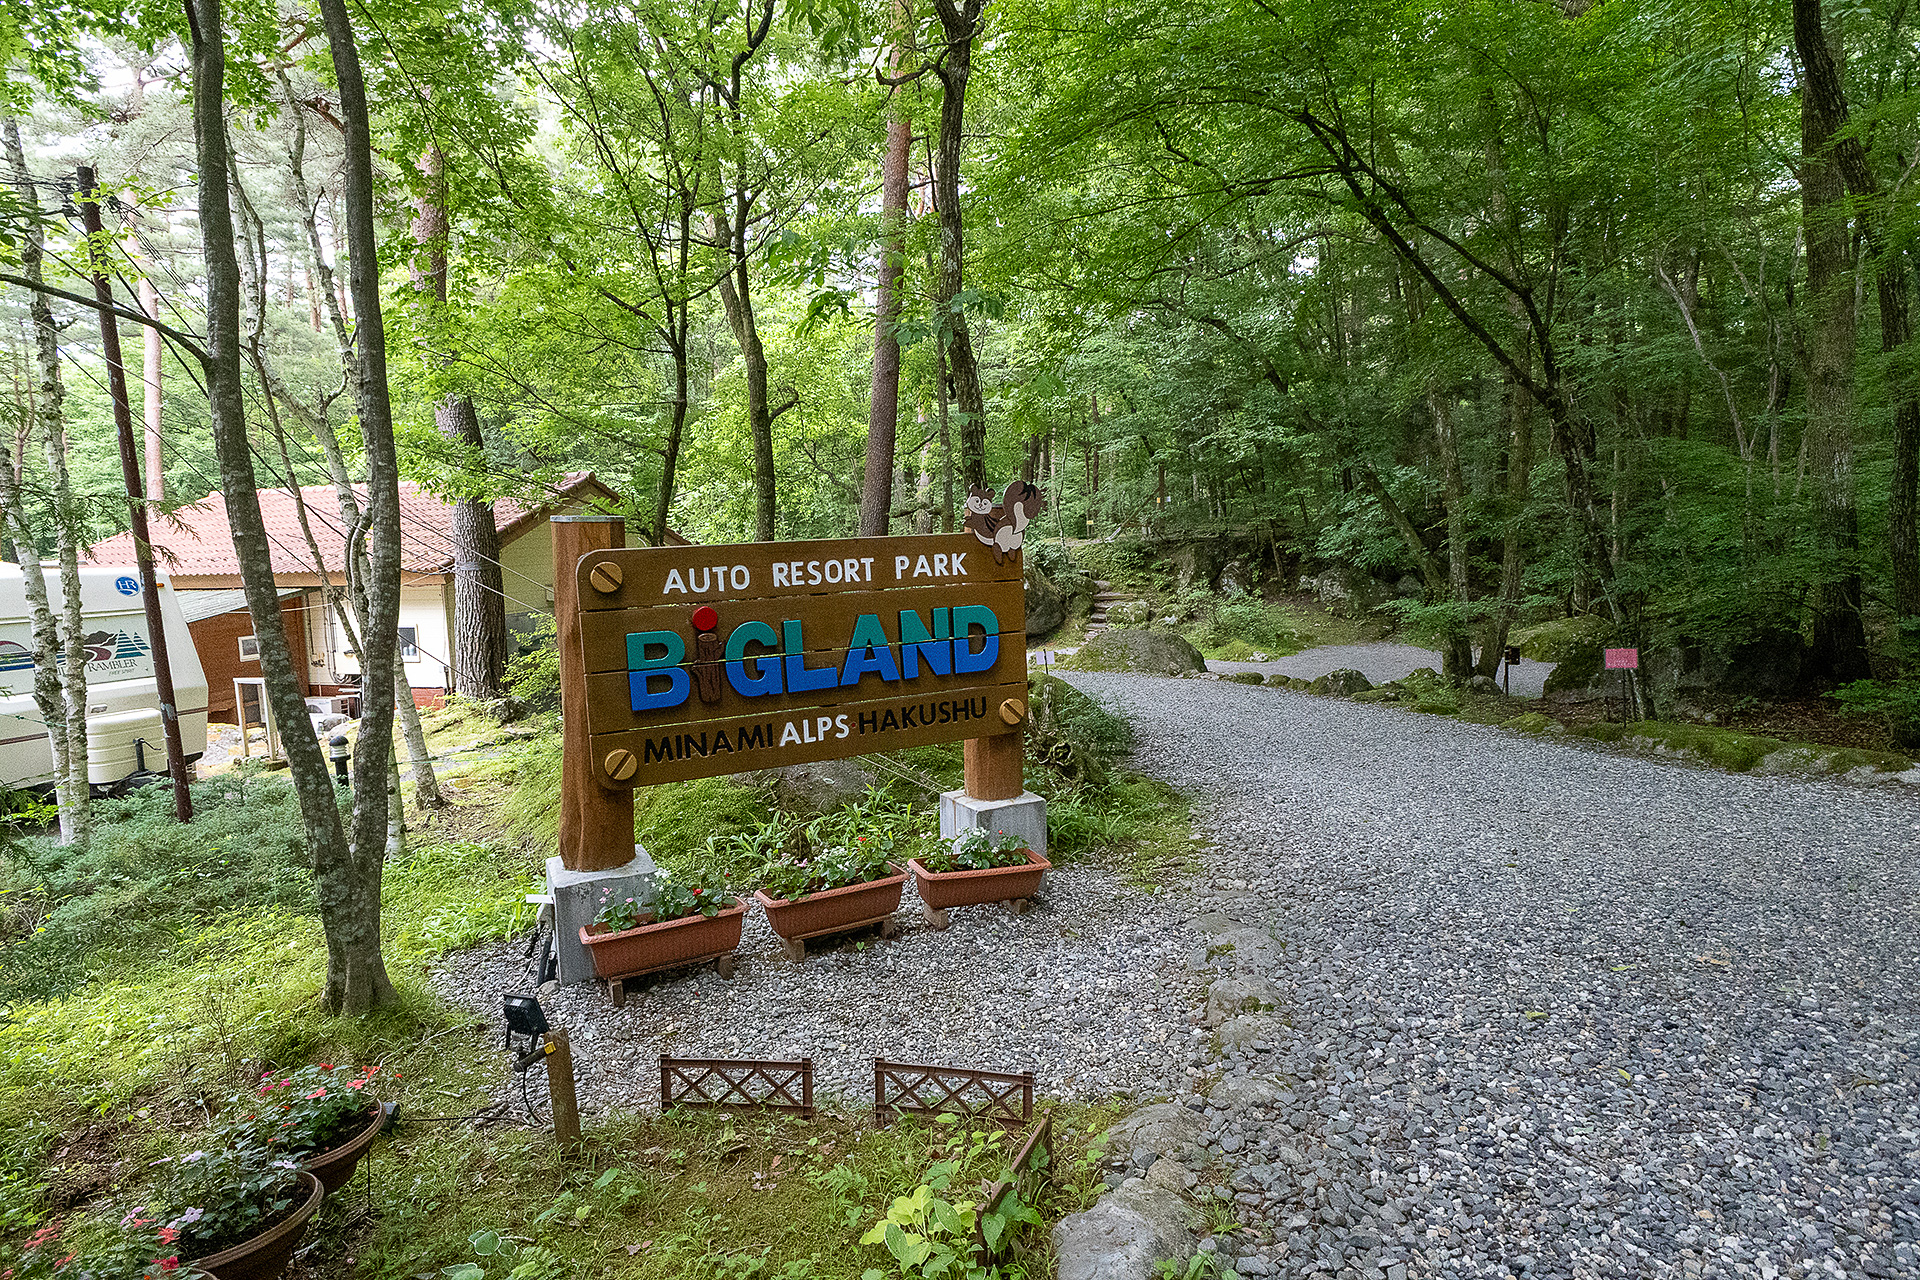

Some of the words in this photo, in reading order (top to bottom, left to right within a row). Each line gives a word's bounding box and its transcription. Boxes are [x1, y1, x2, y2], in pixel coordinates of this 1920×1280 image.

[117, 580, 137, 589] HR
[663, 565, 750, 594] AUTO
[772, 558, 875, 588] RESORT
[895, 552, 968, 580] PARK
[87, 658, 138, 672] RAMBLER
[644, 722, 774, 765] MINAMI
[779, 713, 850, 747] ALPS
[858, 695, 988, 735] HAKUSHU
